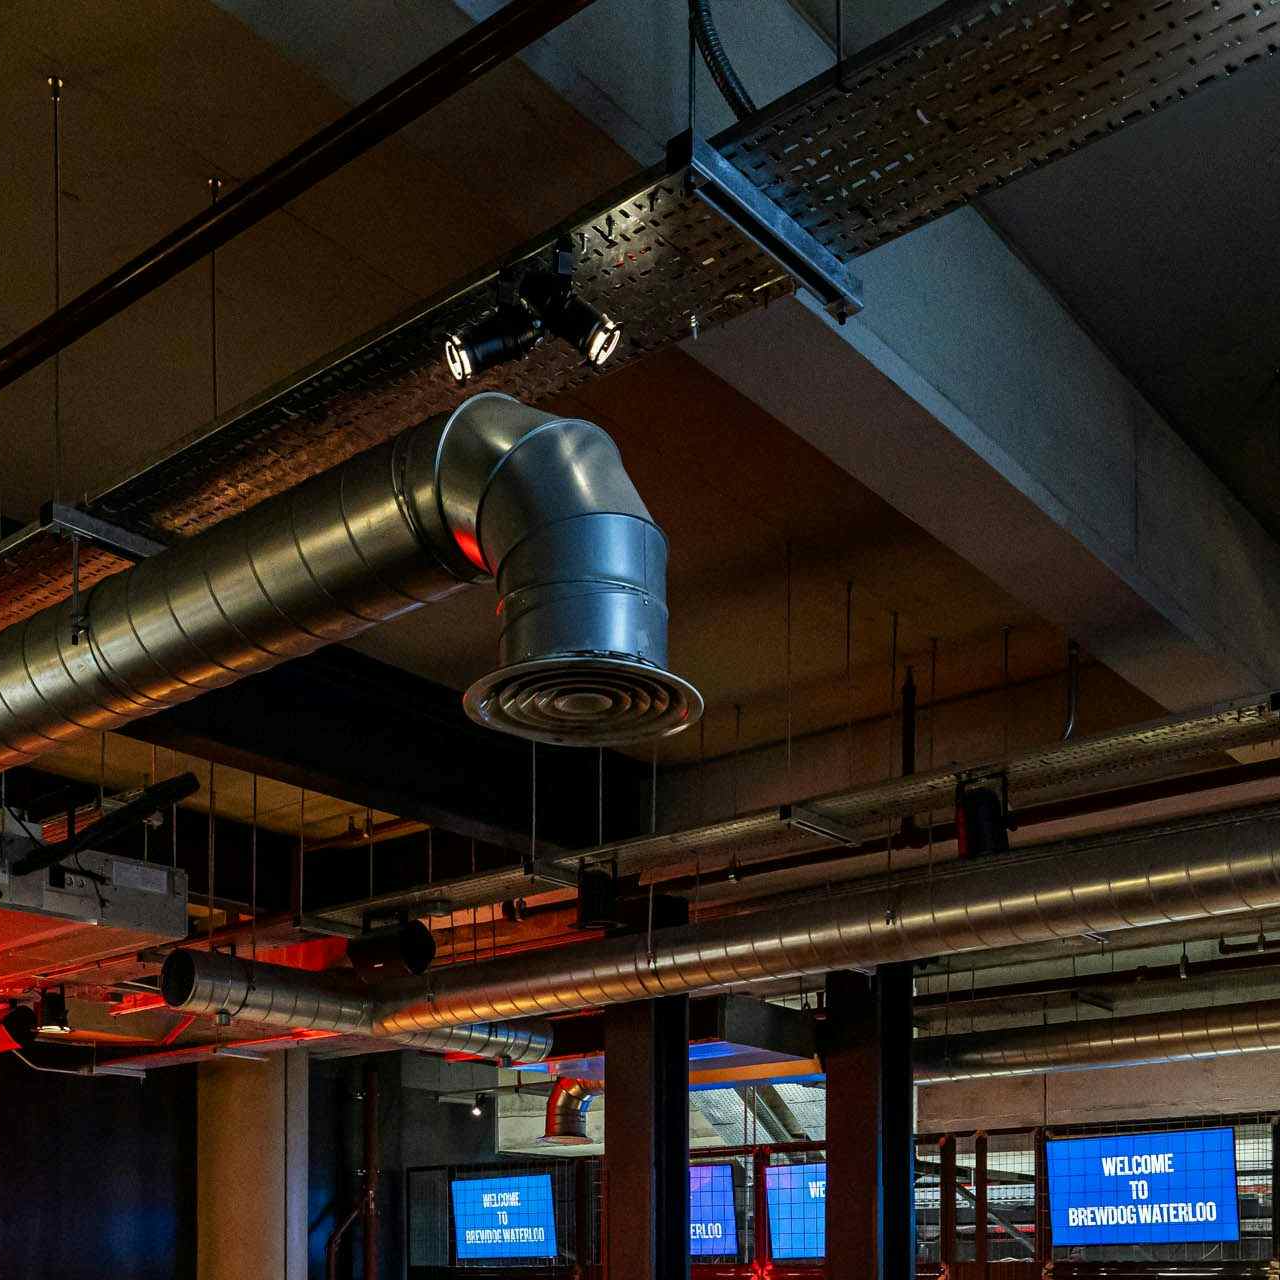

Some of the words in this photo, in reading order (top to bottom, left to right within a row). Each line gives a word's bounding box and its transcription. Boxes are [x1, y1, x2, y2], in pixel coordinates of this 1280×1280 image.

[1101, 1153, 1175, 1177] WELCOME
[1129, 1180, 1149, 1200] TO
[482, 1192, 521, 1209] WELCOME
[496, 1211, 509, 1226] TO
[1068, 1205, 1137, 1227] BREWDOG
[1137, 1201, 1217, 1225] WATERLOO
[502, 1227, 545, 1243] WATERLOO
[689, 1223, 722, 1239] ERLOO
